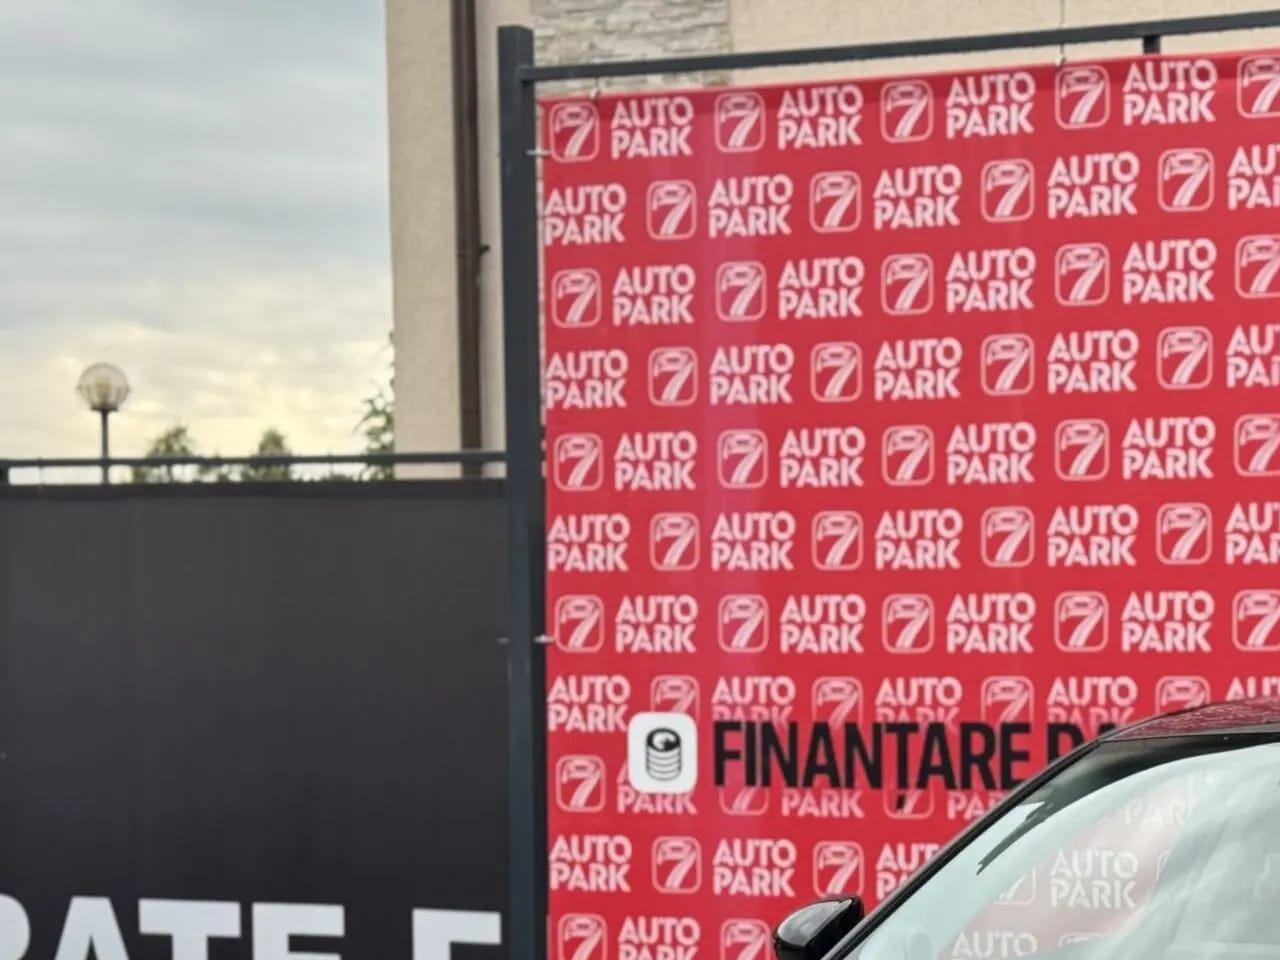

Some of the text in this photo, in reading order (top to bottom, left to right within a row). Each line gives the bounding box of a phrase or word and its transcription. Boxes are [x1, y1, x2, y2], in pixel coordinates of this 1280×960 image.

[945, 72, 1036, 107] AUTO
[1123, 59, 1217, 97] AUTO
[611, 96, 694, 129] AUTO
[777, 84, 863, 121] AUTO
[1123, 89, 1216, 127] PARK
[777, 114, 862, 150] PARK
[946, 101, 1034, 140] PARK
[611, 125, 693, 160] PARK
[873, 164, 963, 201] AUTO
[1047, 151, 1140, 189] AUTO
[543, 183, 627, 217] AUTO
[707, 174, 794, 211] AUTO
[1048, 181, 1138, 219] PARK
[708, 202, 792, 239] PARK
[873, 193, 960, 230] PARK
[543, 213, 625, 246] PARK
[945, 247, 1036, 282] AUTO
[1122, 238, 1217, 273] AUTO
[612, 264, 696, 299] AUTO
[778, 256, 865, 290] AUTO
[1122, 267, 1214, 304] PARK
[612, 292, 694, 326] PARK
[778, 286, 863, 320] PARK
[946, 278, 1034, 313] PARK
[709, 343, 794, 380] AUTO
[874, 337, 963, 371] AUTO
[1047, 328, 1139, 363] AUTO
[545, 349, 629, 383] AUTO
[1048, 359, 1137, 394] PARK
[545, 376, 627, 410] PARK
[709, 370, 792, 406] PARK
[874, 367, 960, 401] PARK
[614, 430, 698, 462] AUTO
[779, 426, 866, 459] AUTO
[946, 421, 1036, 455] AUTO
[1122, 416, 1216, 450] AUTO
[615, 460, 696, 491] PARK
[780, 456, 864, 488] PARK
[947, 451, 1034, 485] PARK
[1122, 446, 1214, 480] PARK
[548, 513, 631, 545] AUTO
[710, 511, 796, 544] AUTO
[874, 508, 963, 544] AUTO
[1047, 504, 1139, 537] AUTO
[548, 541, 628, 572] PARK
[711, 542, 794, 571] PARK
[875, 535, 960, 570] PARK
[1047, 535, 1136, 567] PARK
[615, 594, 699, 625] AUTO
[780, 594, 866, 626] AUTO
[946, 592, 1036, 626] AUTO
[1121, 590, 1215, 623] AUTO
[615, 623, 696, 653] PARK
[780, 622, 864, 653] PARK
[947, 622, 1034, 653] PARK
[1121, 620, 1212, 652] PARK
[548, 675, 631, 704] AUTO
[711, 676, 796, 707] AUTO
[875, 676, 962, 708] AUTO
[1047, 676, 1138, 706] AUTO
[548, 703, 629, 733] PARK
[781, 789, 865, 819] PARK
[549, 835, 632, 866] AUTO
[712, 838, 797, 868] AUTO
[1051, 850, 1138, 878] AUTO
[549, 861, 630, 892] PARK
[713, 866, 795, 897] PARK
[1051, 879, 1137, 909] PARK
[618, 916, 700, 946] AUTO
